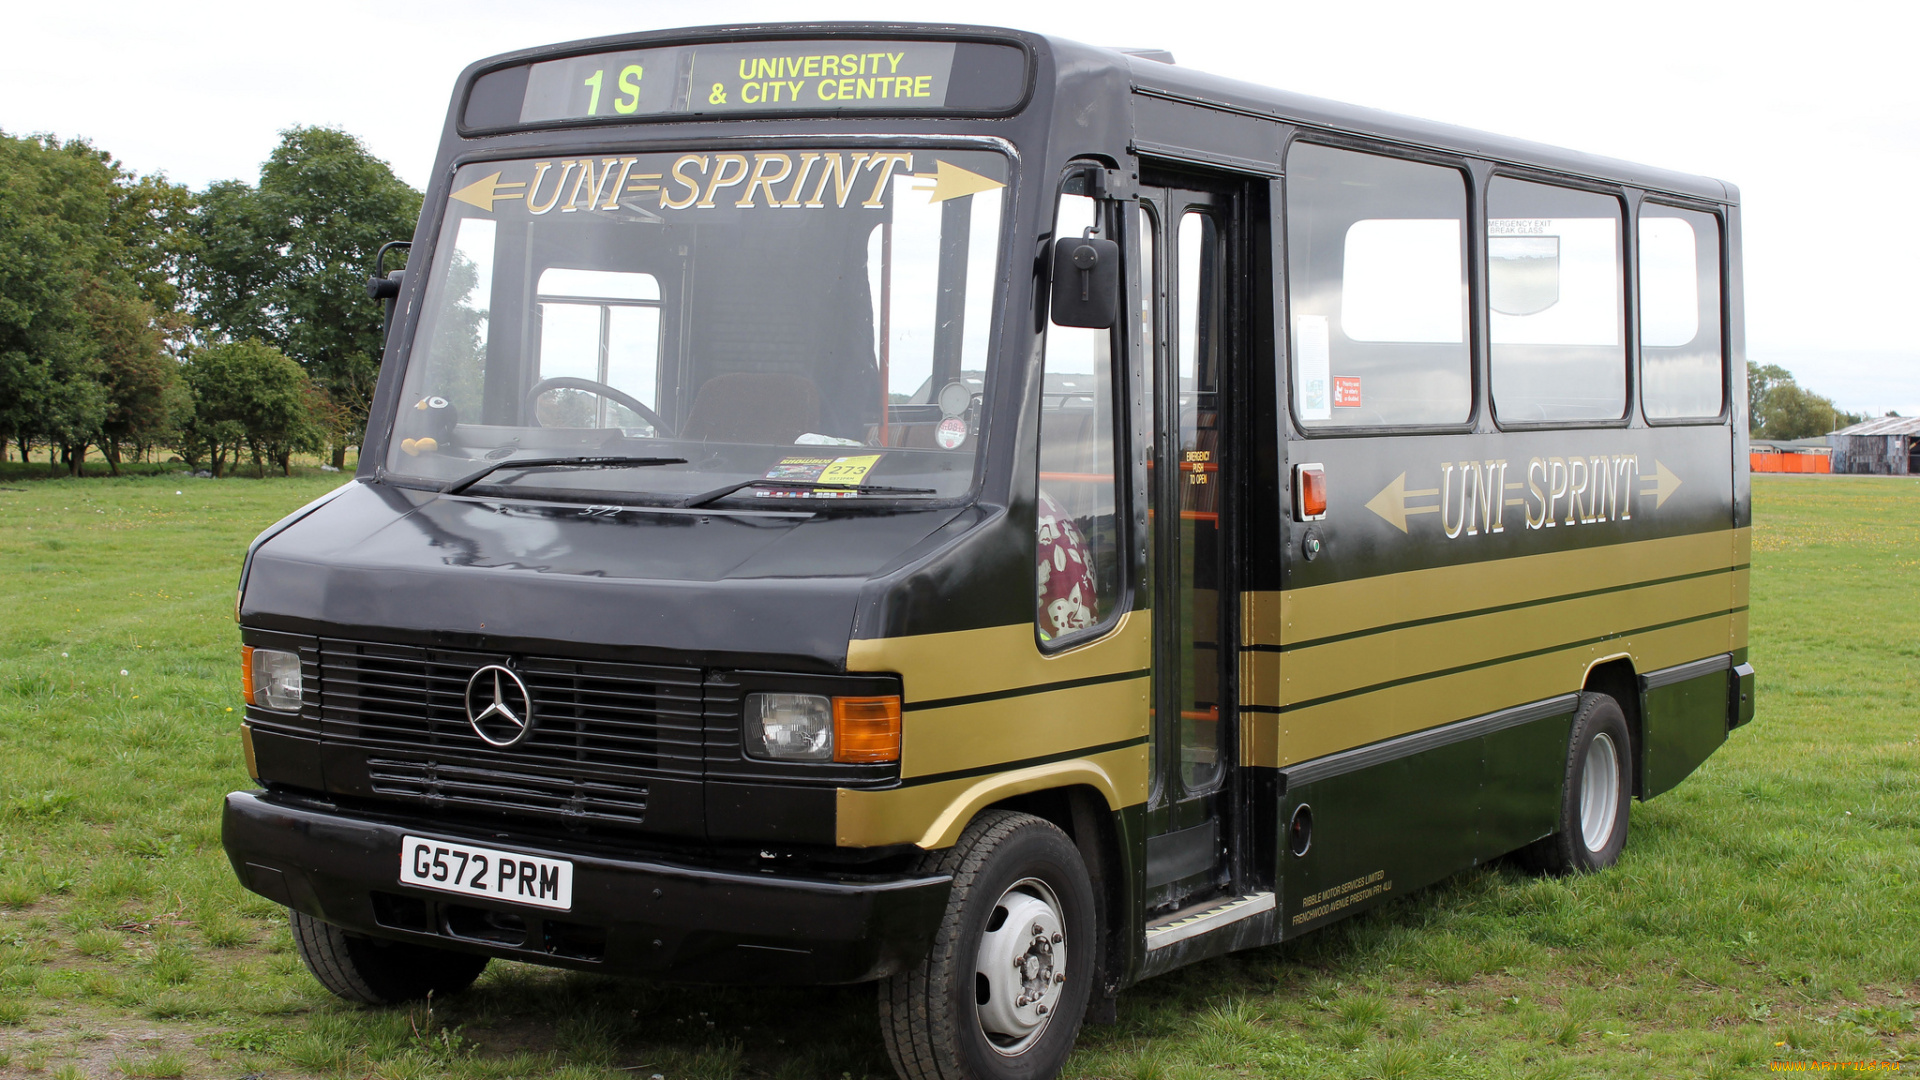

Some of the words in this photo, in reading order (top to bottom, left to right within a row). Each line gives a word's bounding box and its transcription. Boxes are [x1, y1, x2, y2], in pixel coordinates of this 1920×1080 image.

[739, 53, 905, 80] UNIVERSITY
[709, 86, 727, 104] &
[740, 80, 809, 104] CITY
[818, 76, 932, 100] CENTRE
[660, 152, 913, 210] SPRINT
[1535, 219, 1552, 227] EXIT
[829, 466, 867, 475] 273
[1190, 474, 1195, 484] TO
[1196, 474, 1208, 484] OPEN
[1192, 463, 1204, 473] PUSH
[1525, 453, 1639, 530] SPRINT
[578, 505, 623, 517] 572
[413, 844, 489, 890] G572
[498, 858, 559, 901] PRM
[1303, 892, 1322, 908] RIBBLE
[1322, 885, 1341, 900] MOTOR
[1341, 876, 1365, 894] SERVICES
[1365, 869, 1385, 885] LIMITED
[1292, 904, 1329, 926] FRENCHWOOD
[1329, 896, 1350, 912] AVENUE
[1350, 888, 1373, 904] PRESTON
[1373, 884, 1382, 896] PR1
